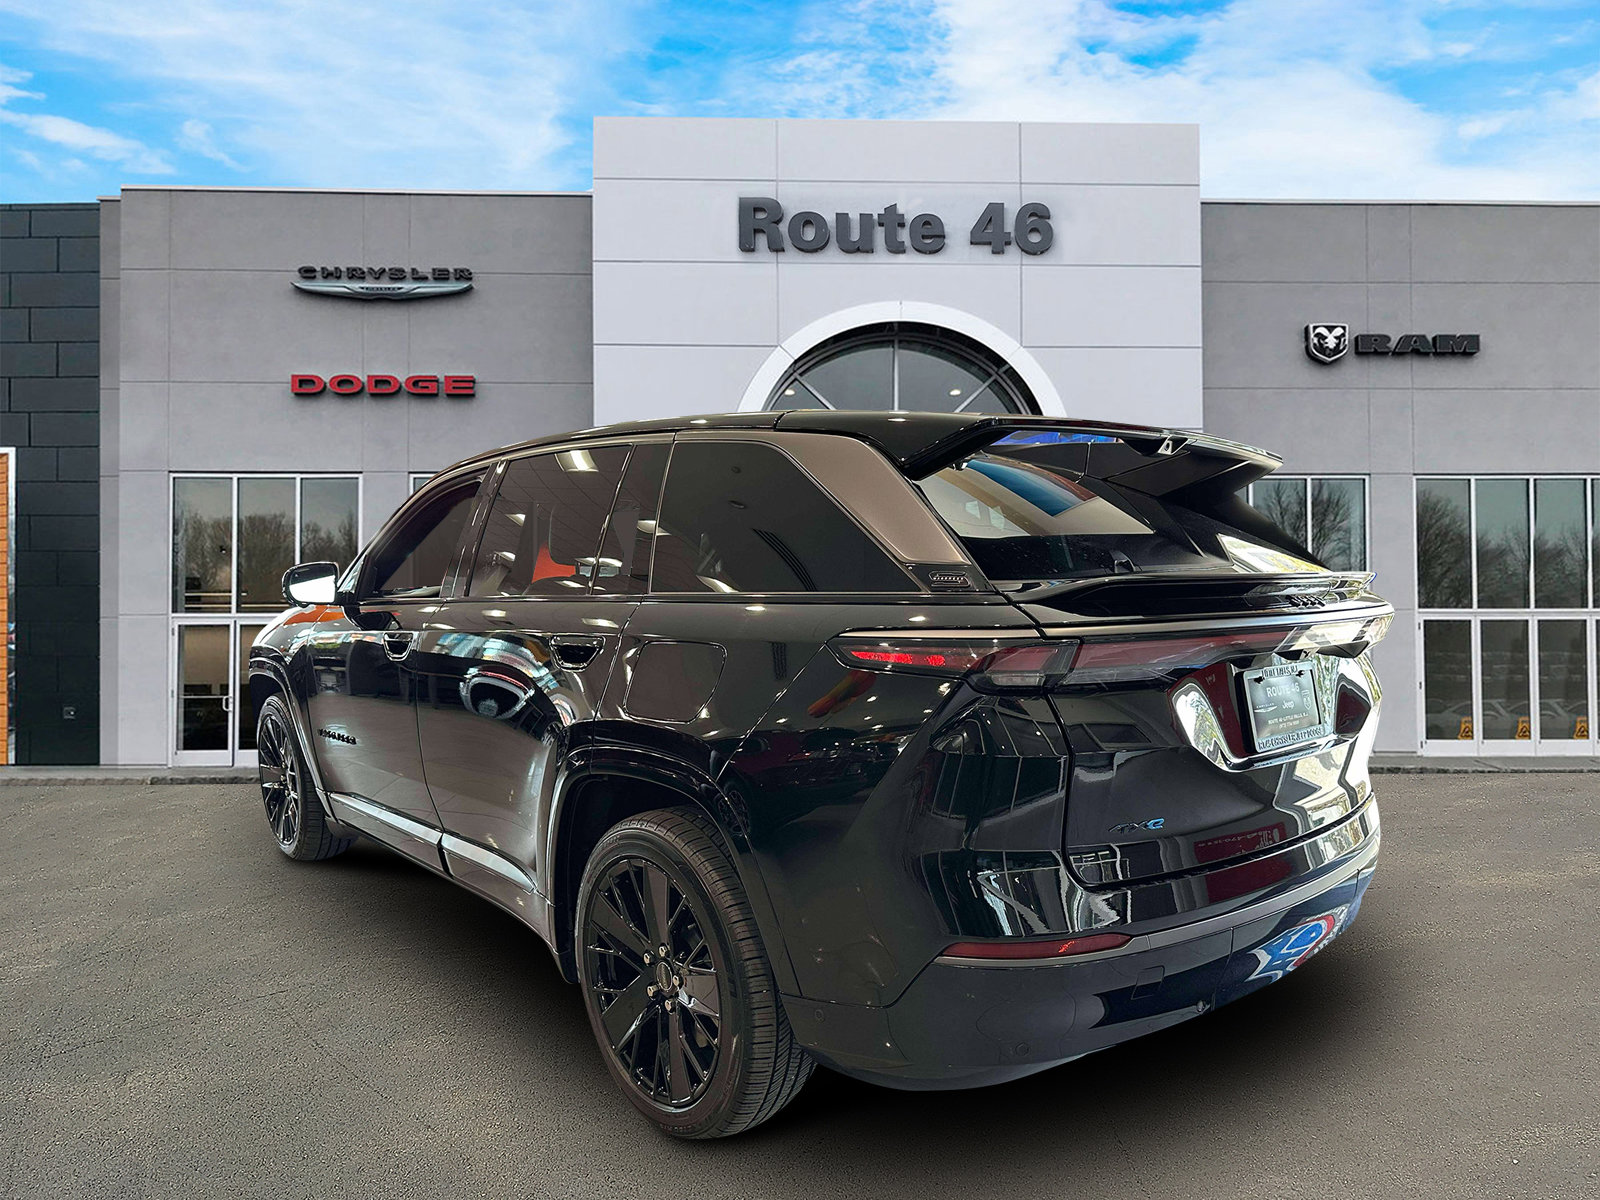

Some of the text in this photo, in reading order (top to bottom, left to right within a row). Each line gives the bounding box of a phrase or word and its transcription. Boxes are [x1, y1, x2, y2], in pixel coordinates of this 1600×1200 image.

[738, 197, 1054, 255] Route 46
[297, 265, 473, 281] CHRYSLER
[1354, 334, 1480, 356] RAM
[290, 374, 476, 397] DODGE
[1266, 685, 1291, 697] ROUTE
